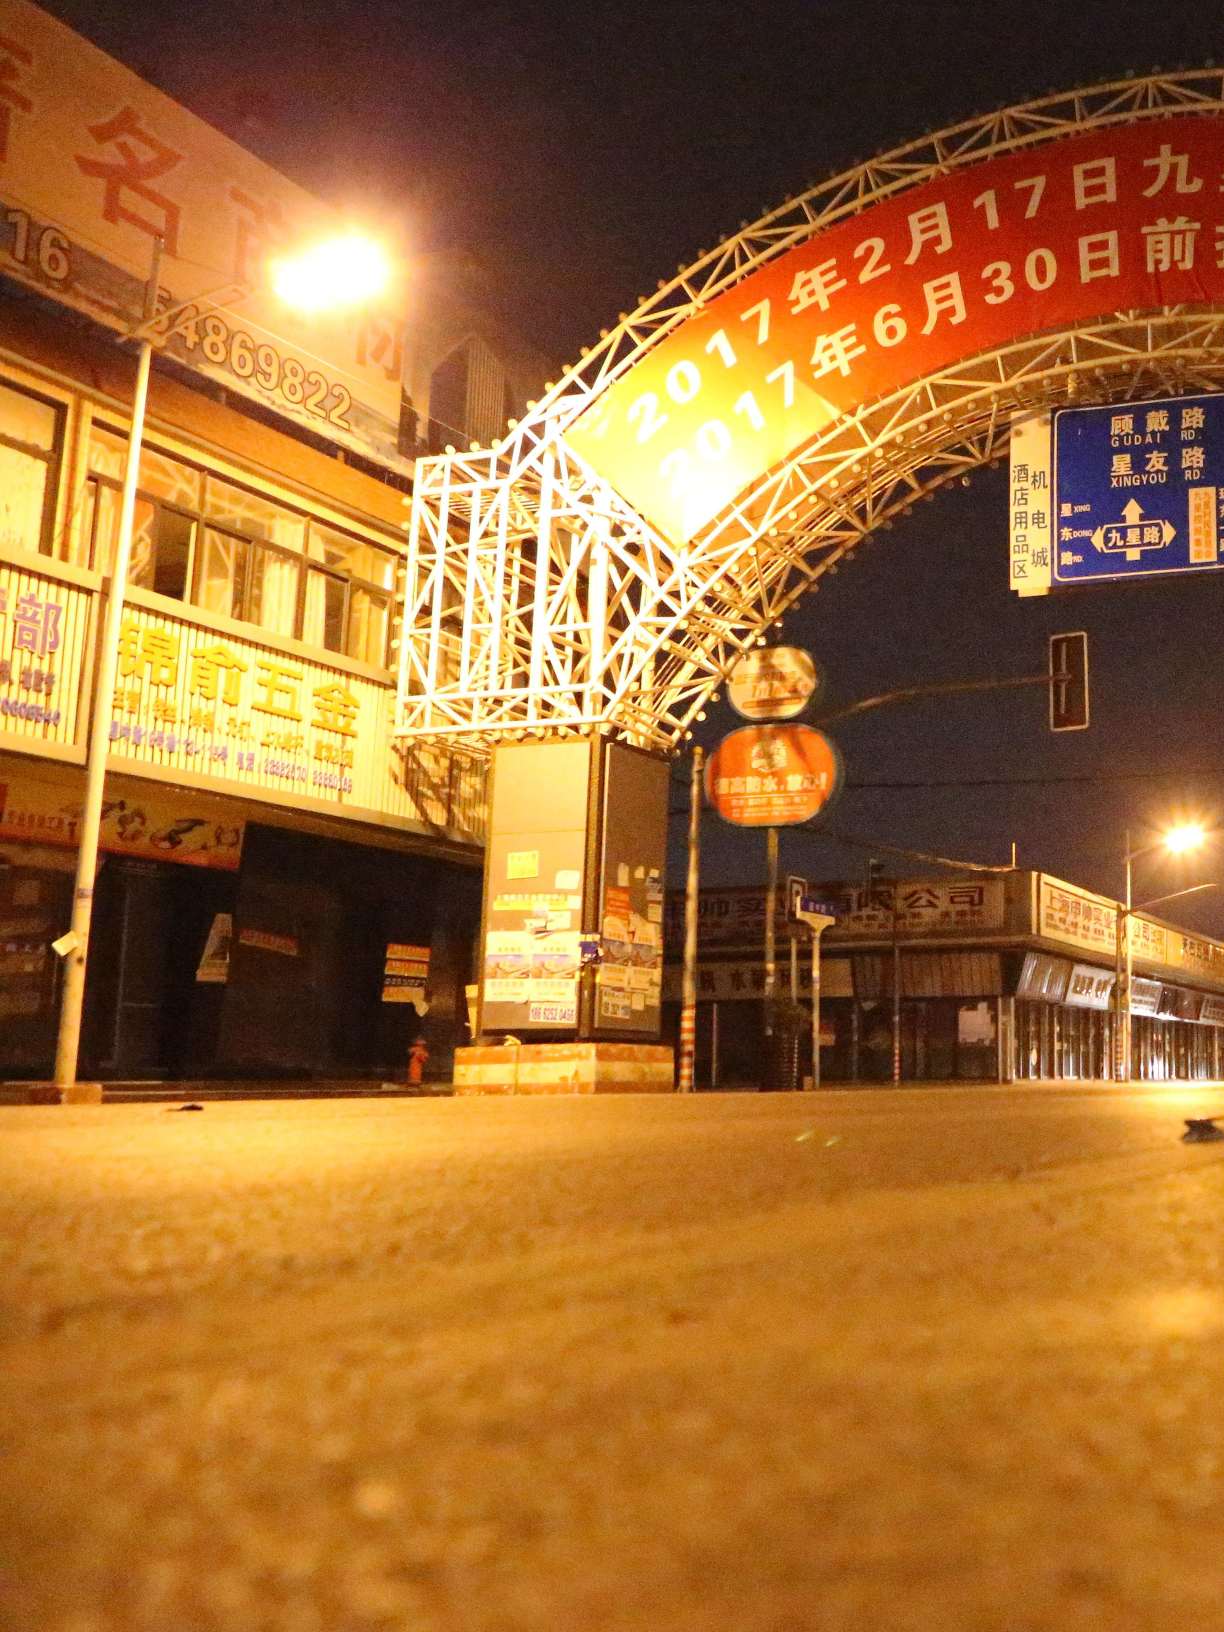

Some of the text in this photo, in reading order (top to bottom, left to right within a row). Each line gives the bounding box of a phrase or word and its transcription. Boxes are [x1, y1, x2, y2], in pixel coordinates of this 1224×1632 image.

[1110, 407, 1205, 436] 顾戴路
[1111, 432, 1161, 448] GUDAI
[1110, 446, 1205, 476] 星友路
[1111, 472, 1167, 488] XINGYOU
[1012, 463, 1030, 580] 酒店用品区
[1030, 470, 1049, 568] 机电城
[1107, 525, 1161, 547] 九星路
